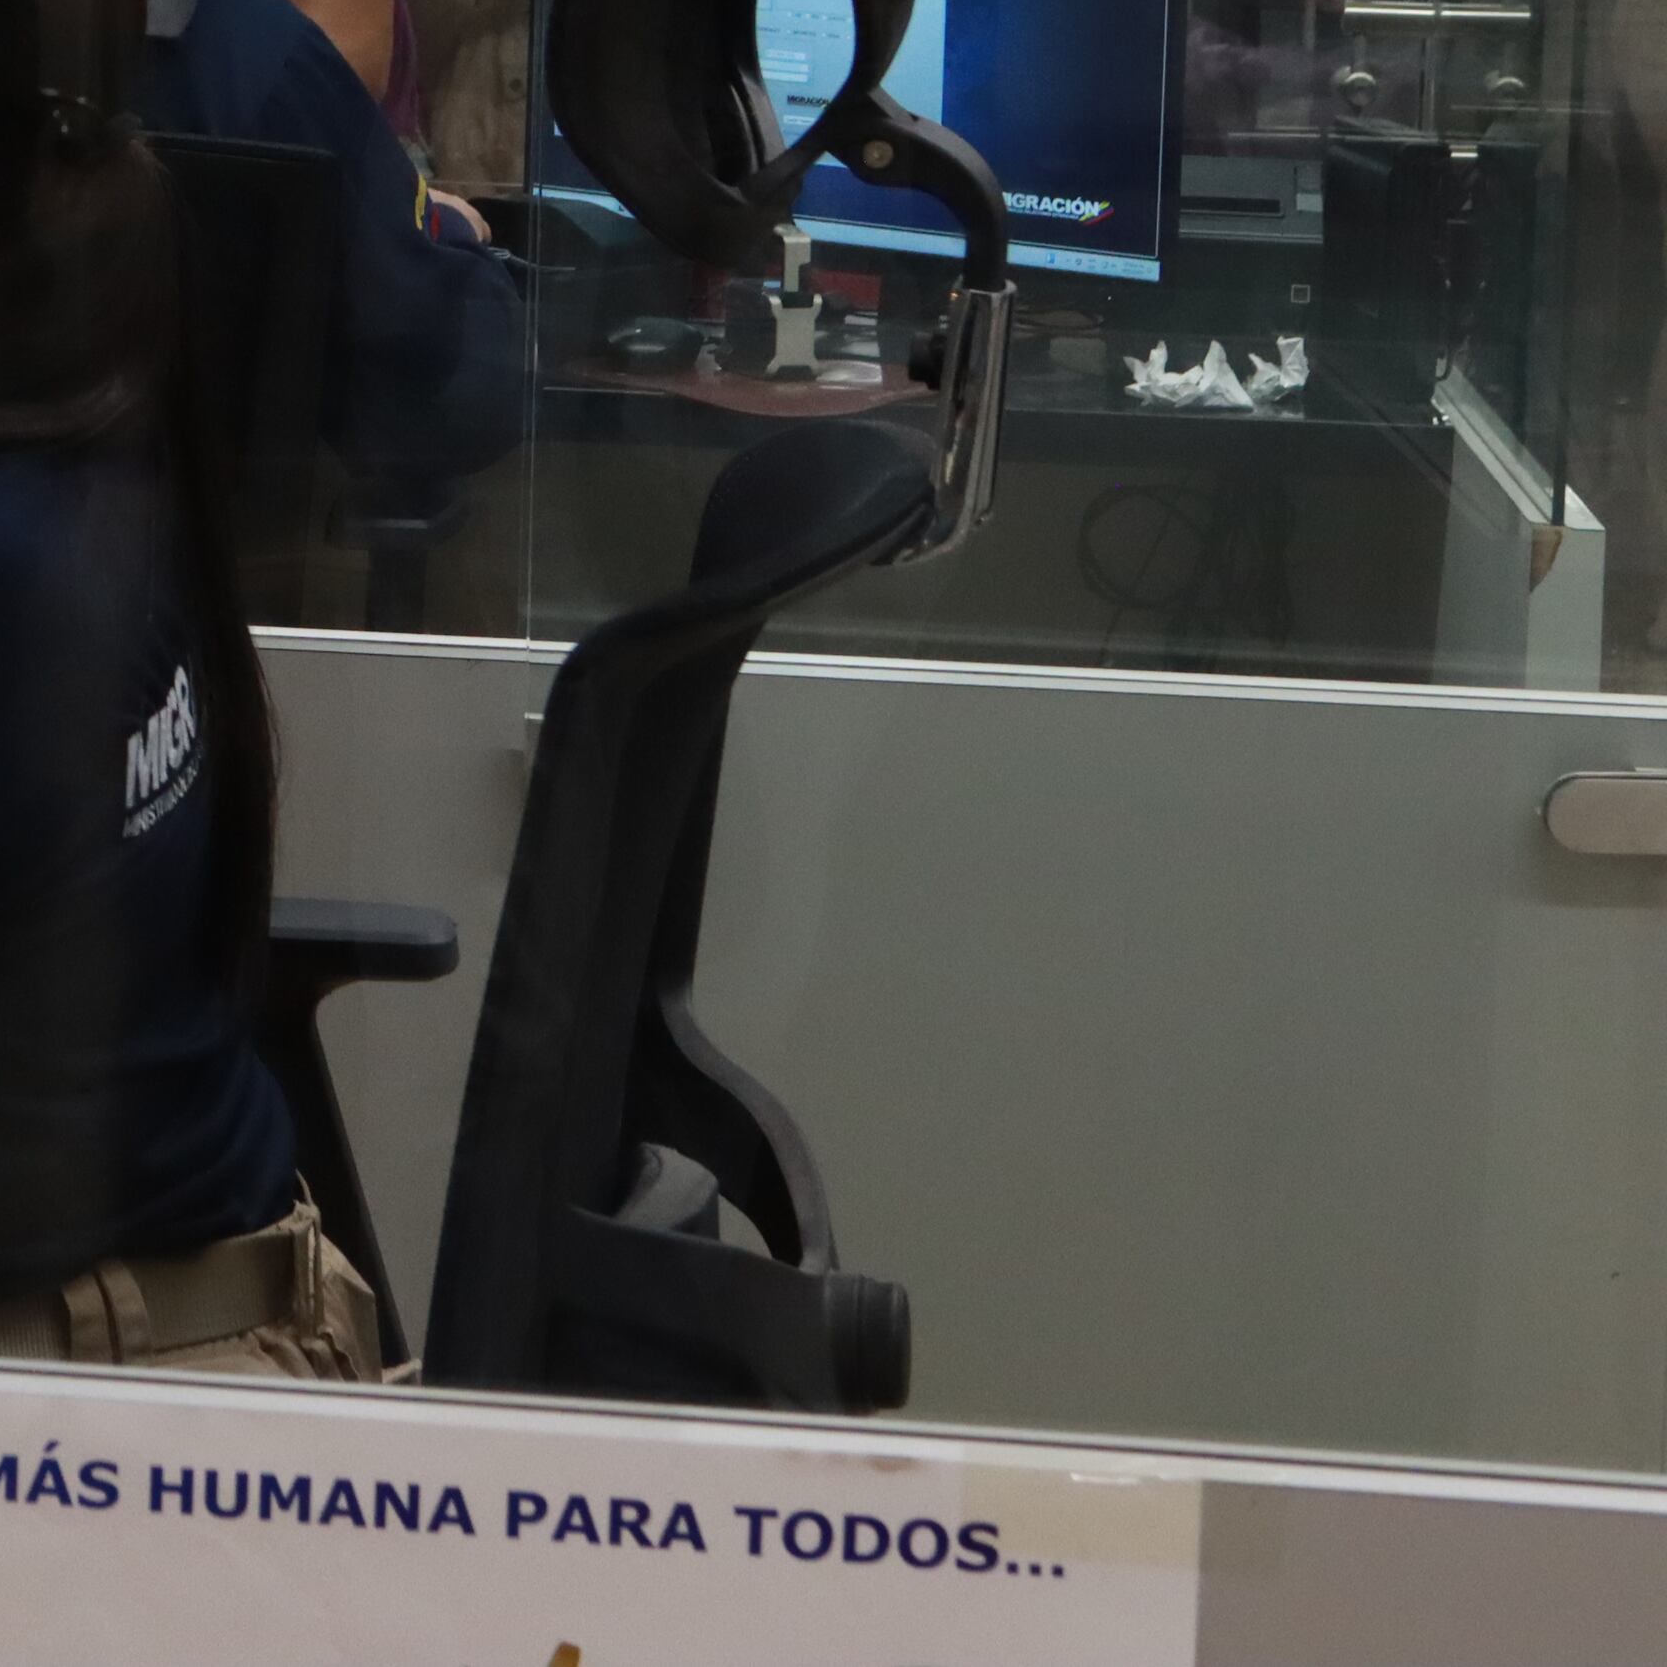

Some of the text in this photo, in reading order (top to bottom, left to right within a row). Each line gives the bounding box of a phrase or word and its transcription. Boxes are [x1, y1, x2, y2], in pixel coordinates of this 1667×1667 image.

[125, 663, 197, 810] MIGR
[148, 1465, 476, 1537] HUMANA
[505, 1489, 708, 1554] PARA
[733, 1506, 1065, 1579] TODOS...
